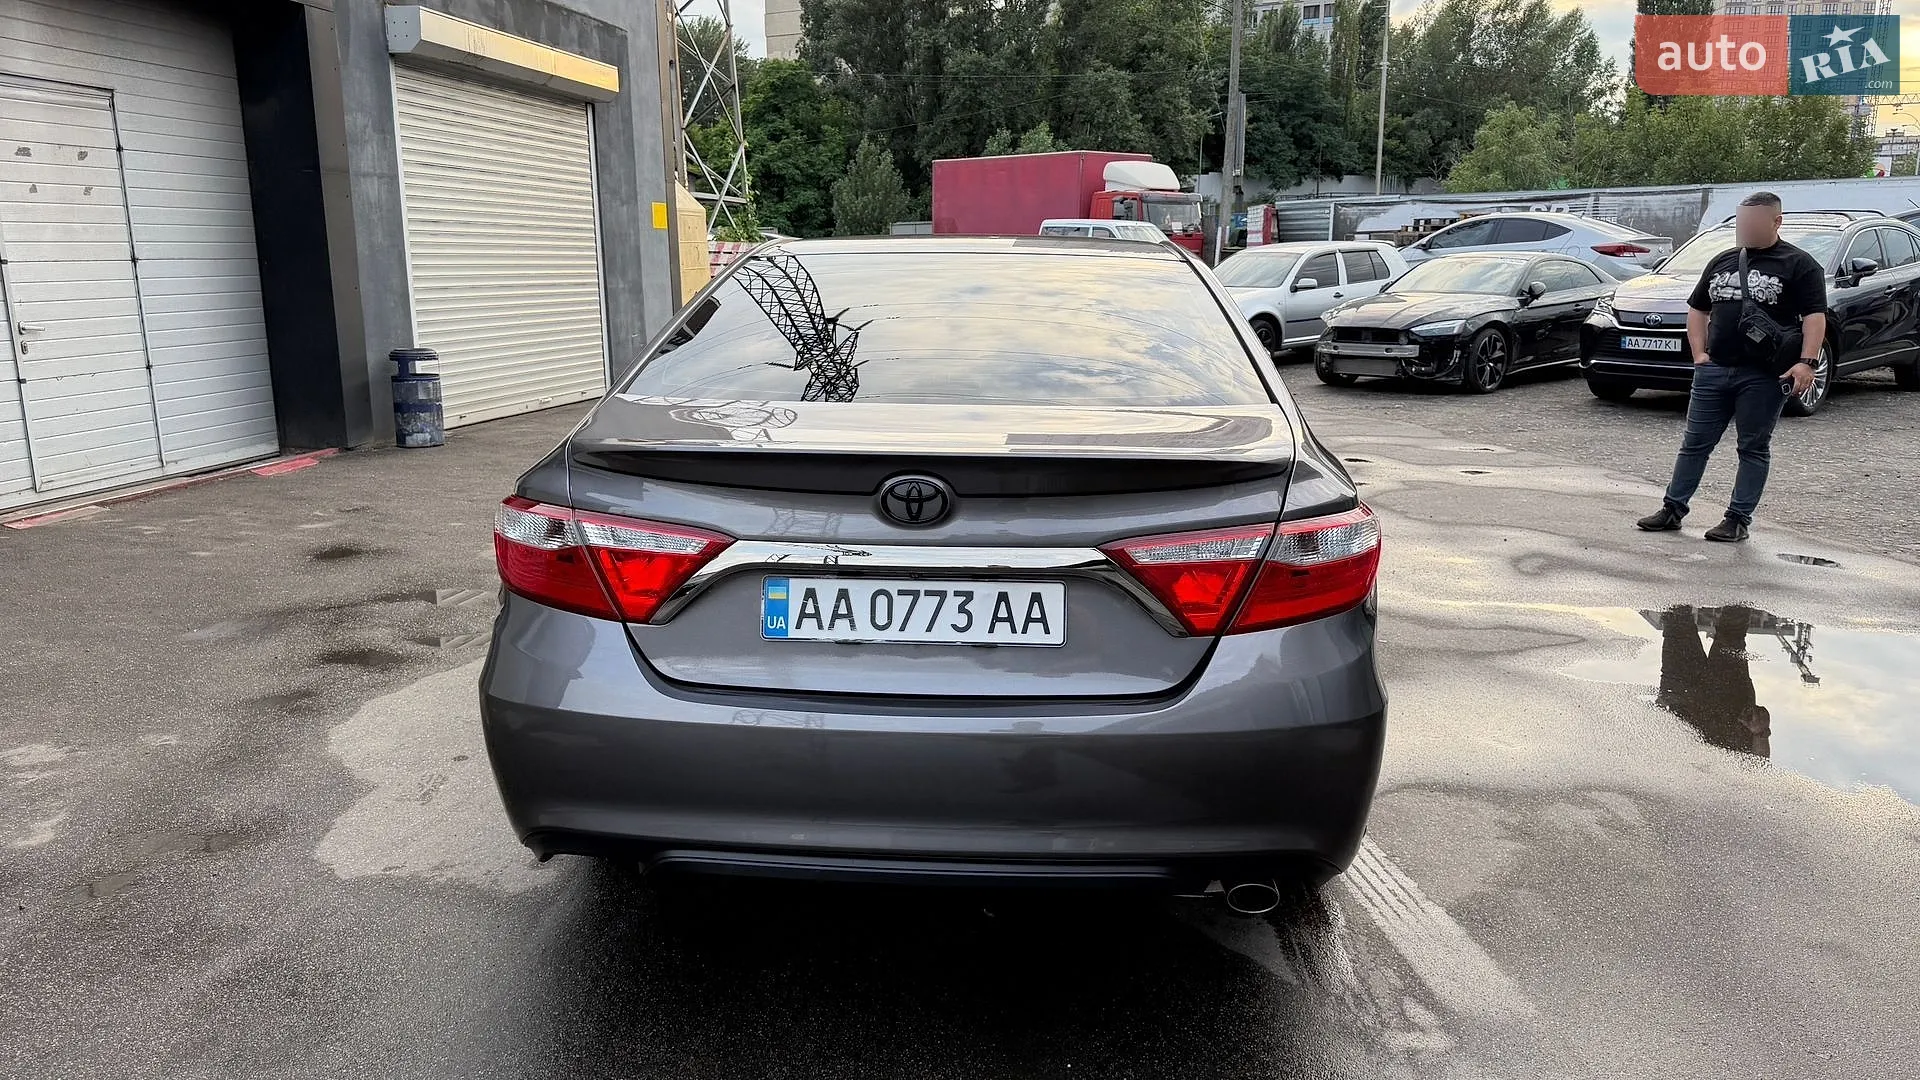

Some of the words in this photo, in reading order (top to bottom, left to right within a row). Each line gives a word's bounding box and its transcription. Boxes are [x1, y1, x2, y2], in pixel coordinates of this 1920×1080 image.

[1627, 338, 1640, 348] AA
[1642, 339, 1663, 349] 7717
[1664, 340, 1677, 350] KI
[794, 587, 858, 632] AA
[869, 588, 975, 634] 0773
[987, 591, 1051, 635] AA
[767, 615, 786, 630] UA
